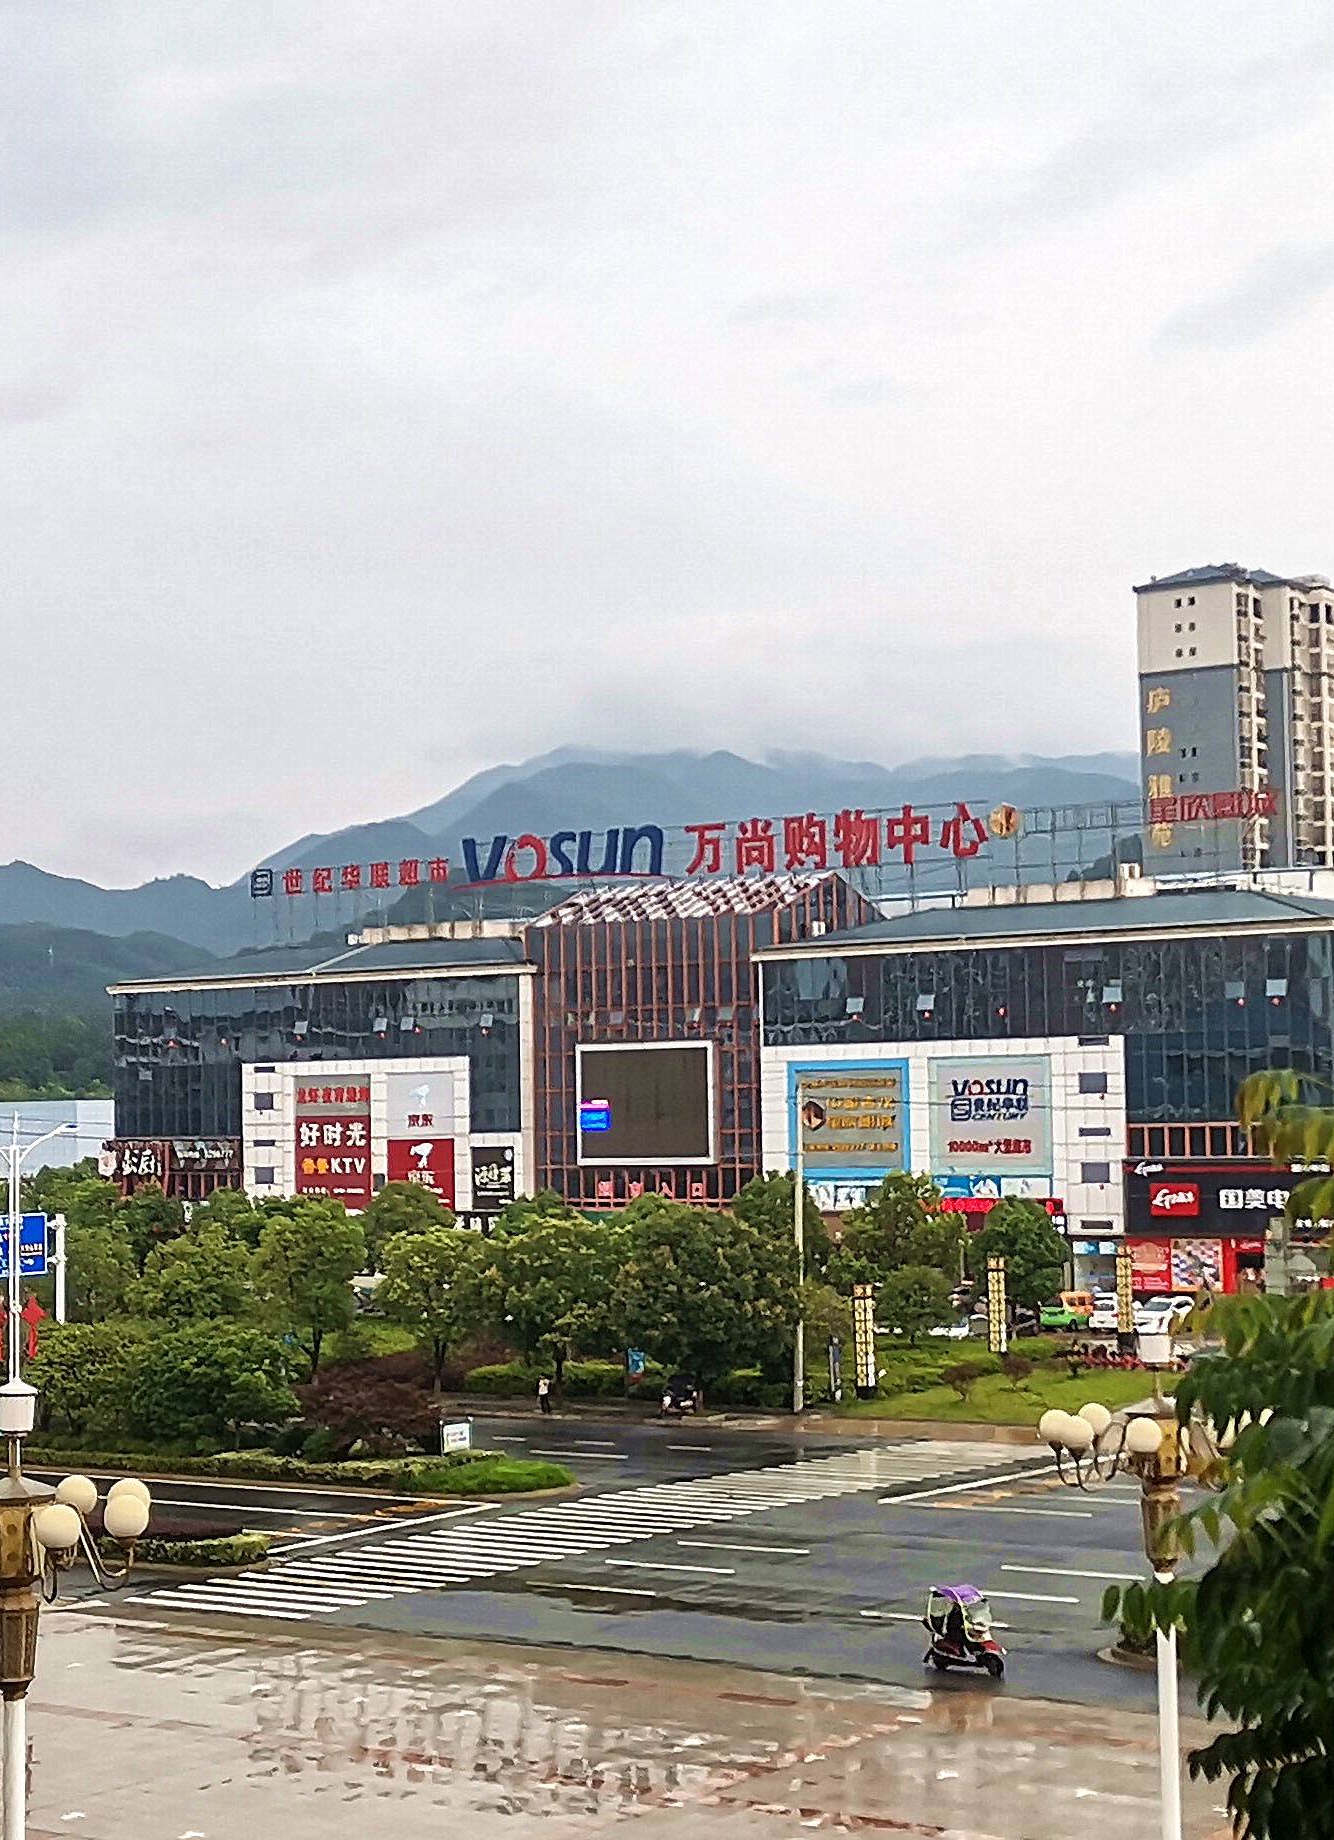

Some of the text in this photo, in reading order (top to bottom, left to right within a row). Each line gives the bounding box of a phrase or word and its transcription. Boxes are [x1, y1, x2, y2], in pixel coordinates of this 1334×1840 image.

[463, 824, 664, 880] vosun
[684, 802, 988, 875] 万尚购物中心
[283, 857, 449, 895] 世纪华联超市
[299, 1122, 367, 1147] 好时光
